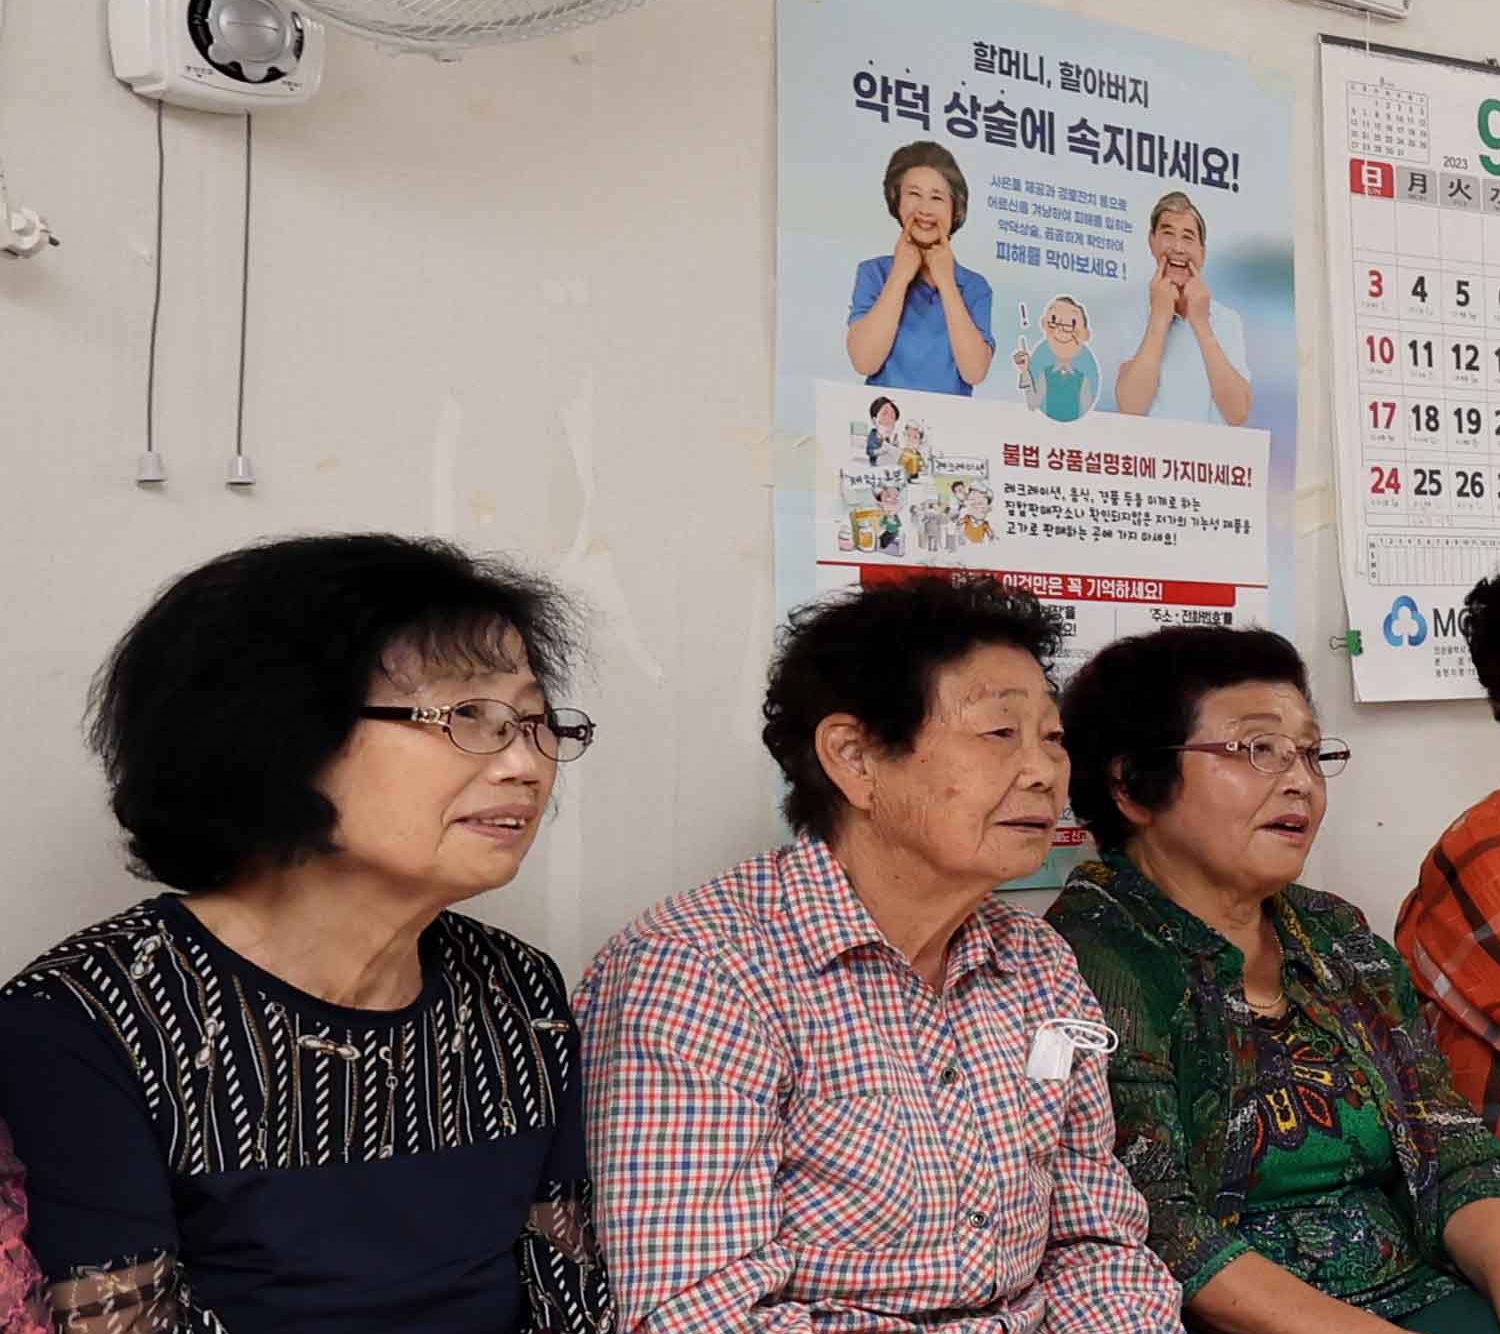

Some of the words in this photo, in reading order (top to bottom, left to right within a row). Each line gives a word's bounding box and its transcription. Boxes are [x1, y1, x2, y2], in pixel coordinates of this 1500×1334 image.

[973, 40, 1052, 90] 할머니,
[1059, 60, 1150, 108] 할아버지
[853, 70, 930, 131] 악덕
[944, 90, 1055, 155] 상술에
[1067, 117, 1240, 192] 속지마세요!
[1443, 156, 1468, 169] 2023
[1361, 165, 1382, 188] 日
[1408, 171, 1427, 194] 月
[1448, 177, 1472, 200] 火
[996, 240, 1040, 267] 피해를
[1046, 249, 1118, 279] 막아보세요
[1368, 270, 1383, 298] 3
[1411, 275, 1427, 303] 4
[1456, 280, 1470, 307] 5
[1366, 335, 1394, 364] 10
[1408, 339, 1434, 368] 11
[1451, 343, 1480, 372] 12
[1368, 401, 1397, 430] 17
[1411, 404, 1440, 432] 18
[1454, 407, 1482, 435] 19
[1002, 443, 1040, 469] 불법
[1047, 447, 1156, 480] 상품설명회에
[1162, 458, 1252, 488] 가지마세요!
[1370, 466, 1401, 495] 24
[1414, 469, 1442, 497] 25
[1456, 471, 1485, 498] 26
[1067, 576, 1082, 597] 꼭
[1087, 578, 1163, 601] 기억하세요!
